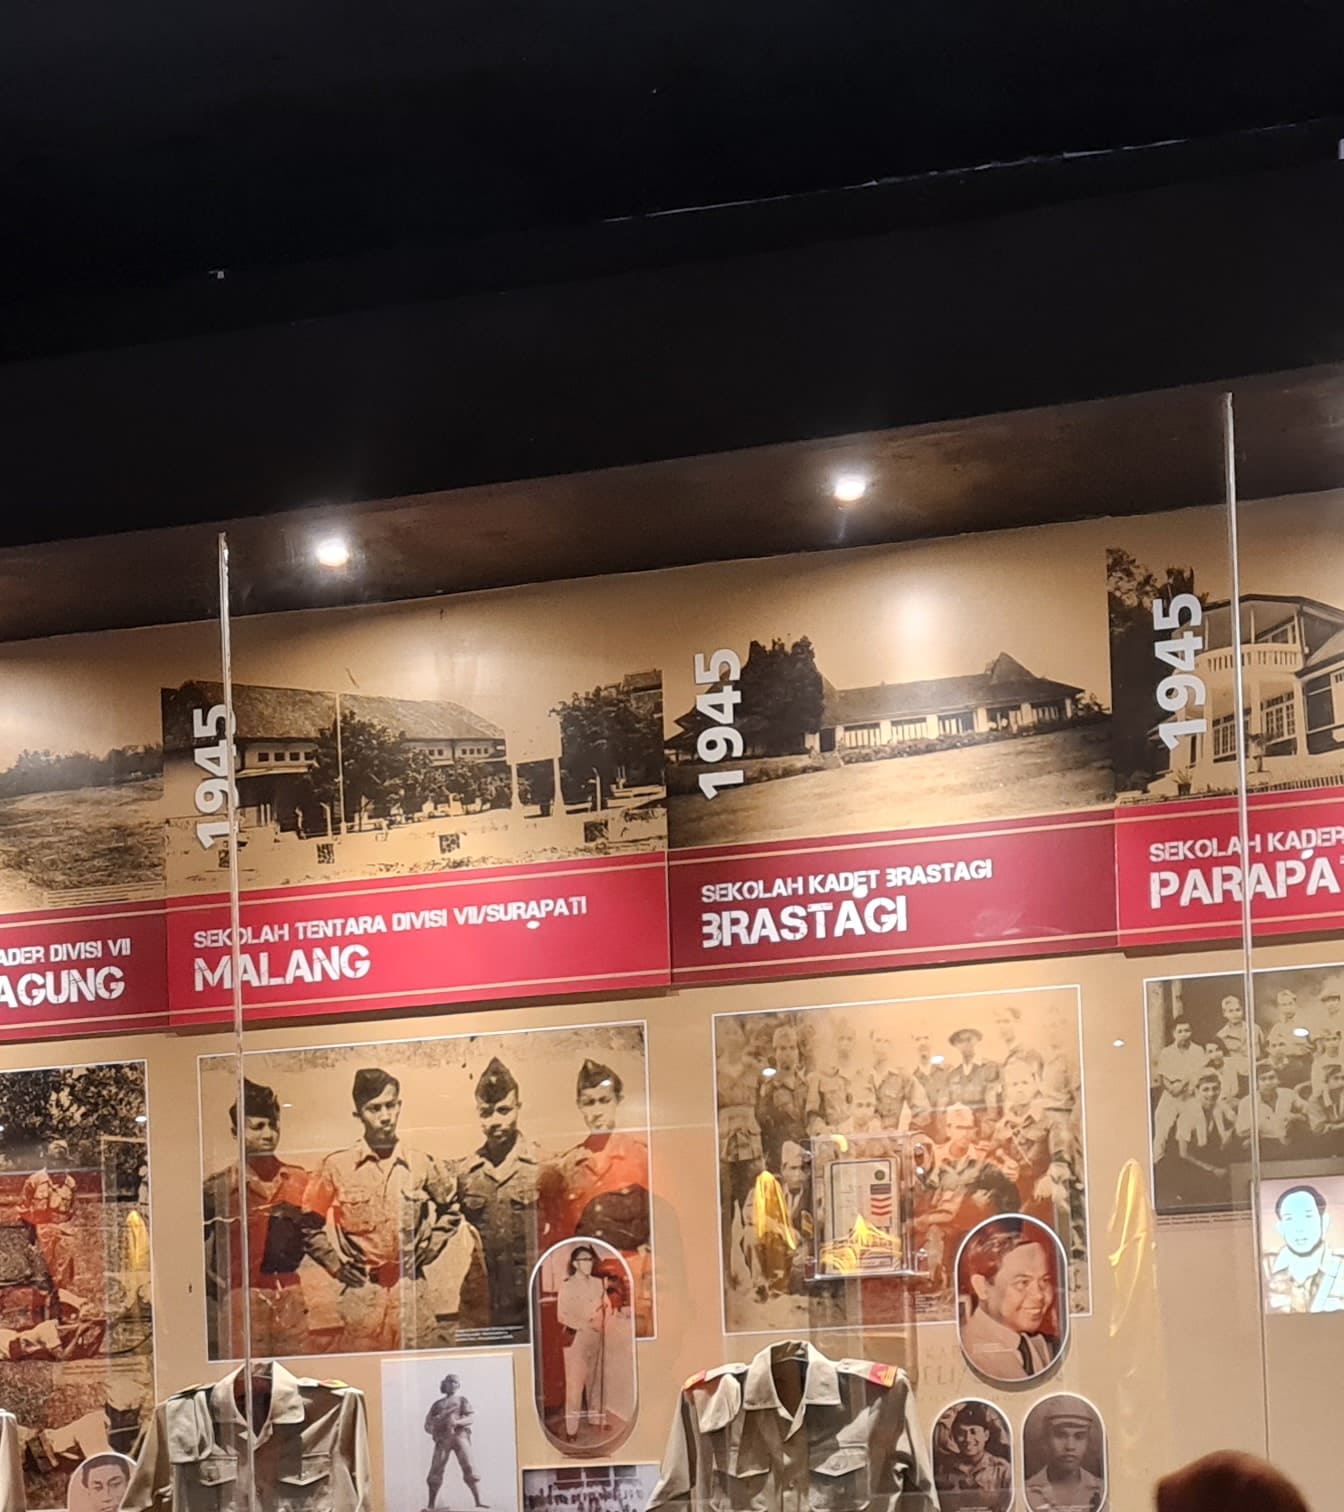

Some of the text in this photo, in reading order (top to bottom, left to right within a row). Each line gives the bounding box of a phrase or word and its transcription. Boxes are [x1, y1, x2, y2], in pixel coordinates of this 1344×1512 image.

[1153, 593, 1207, 750] 1945
[695, 649, 744, 800] 1945
[193, 704, 239, 849] 1945
[1149, 832, 1261, 862] SEKOLAH
[701, 859, 993, 903] SEKOLAH KADET BRASTAGI
[295, 914, 387, 941] TENTARA
[392, 909, 448, 931] DIVISI
[702, 895, 907, 948] BRASTAGI
[50, 940, 102, 962] DIVISI
[108, 938, 131, 956] VII
[194, 944, 372, 992] MALANG
